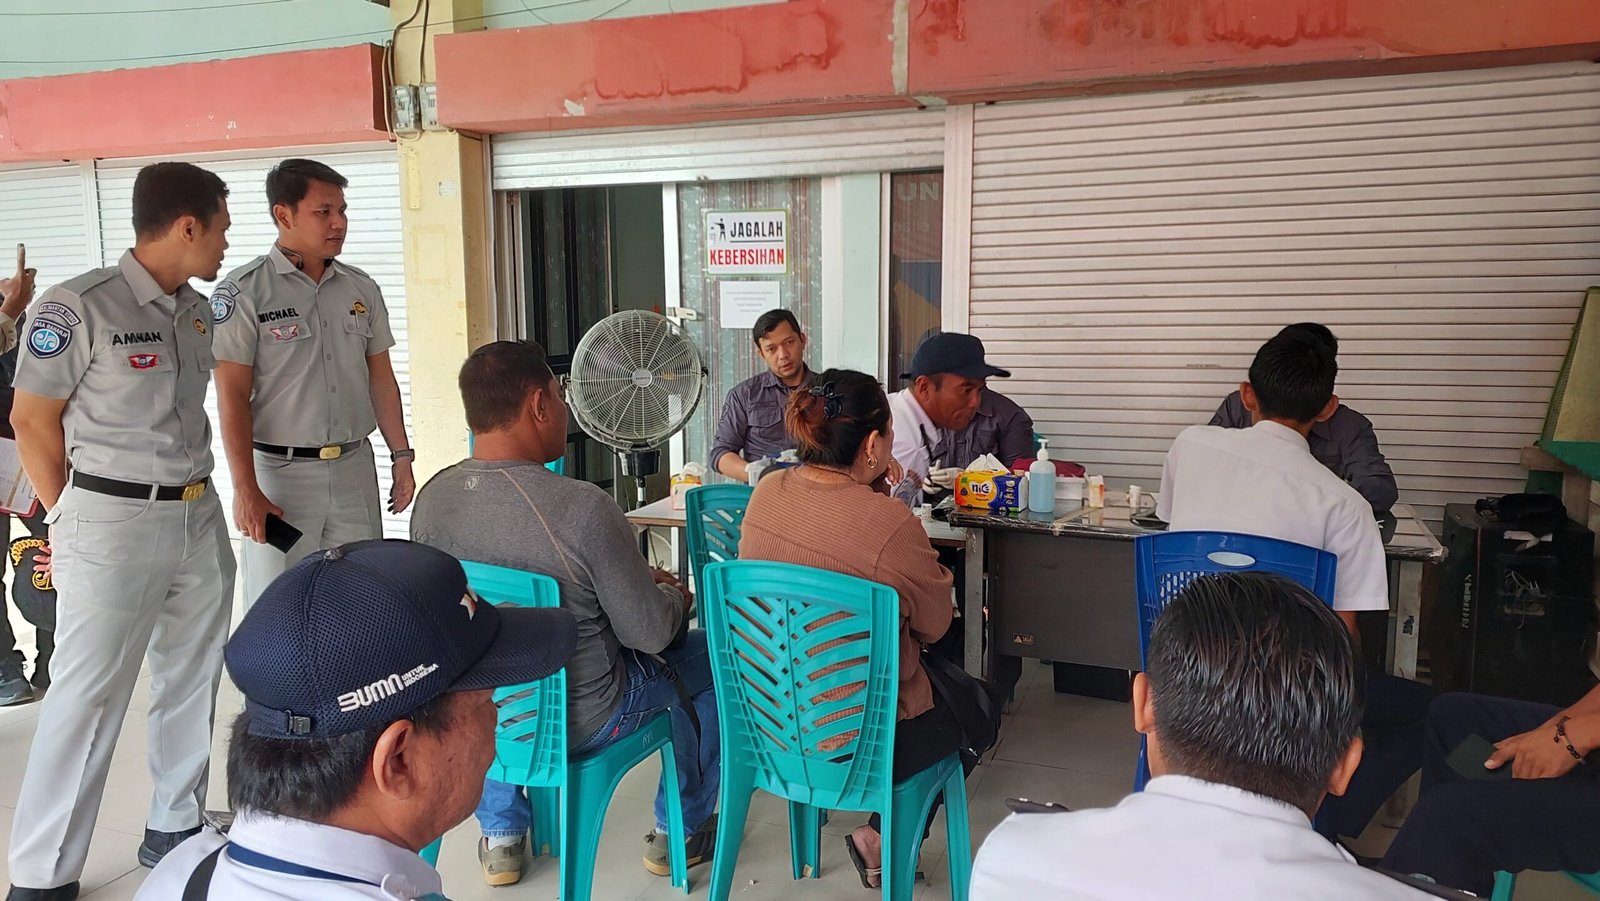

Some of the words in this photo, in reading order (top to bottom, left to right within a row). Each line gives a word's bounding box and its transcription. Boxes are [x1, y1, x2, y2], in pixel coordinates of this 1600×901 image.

[730, 221, 783, 237] JAGALAH
[710, 249, 784, 265] KEBERSIHAN
[258, 308, 299, 323] MICHAEL
[401, 664, 425, 681] UNTUK
[404, 663, 439, 687] INDONESIA
